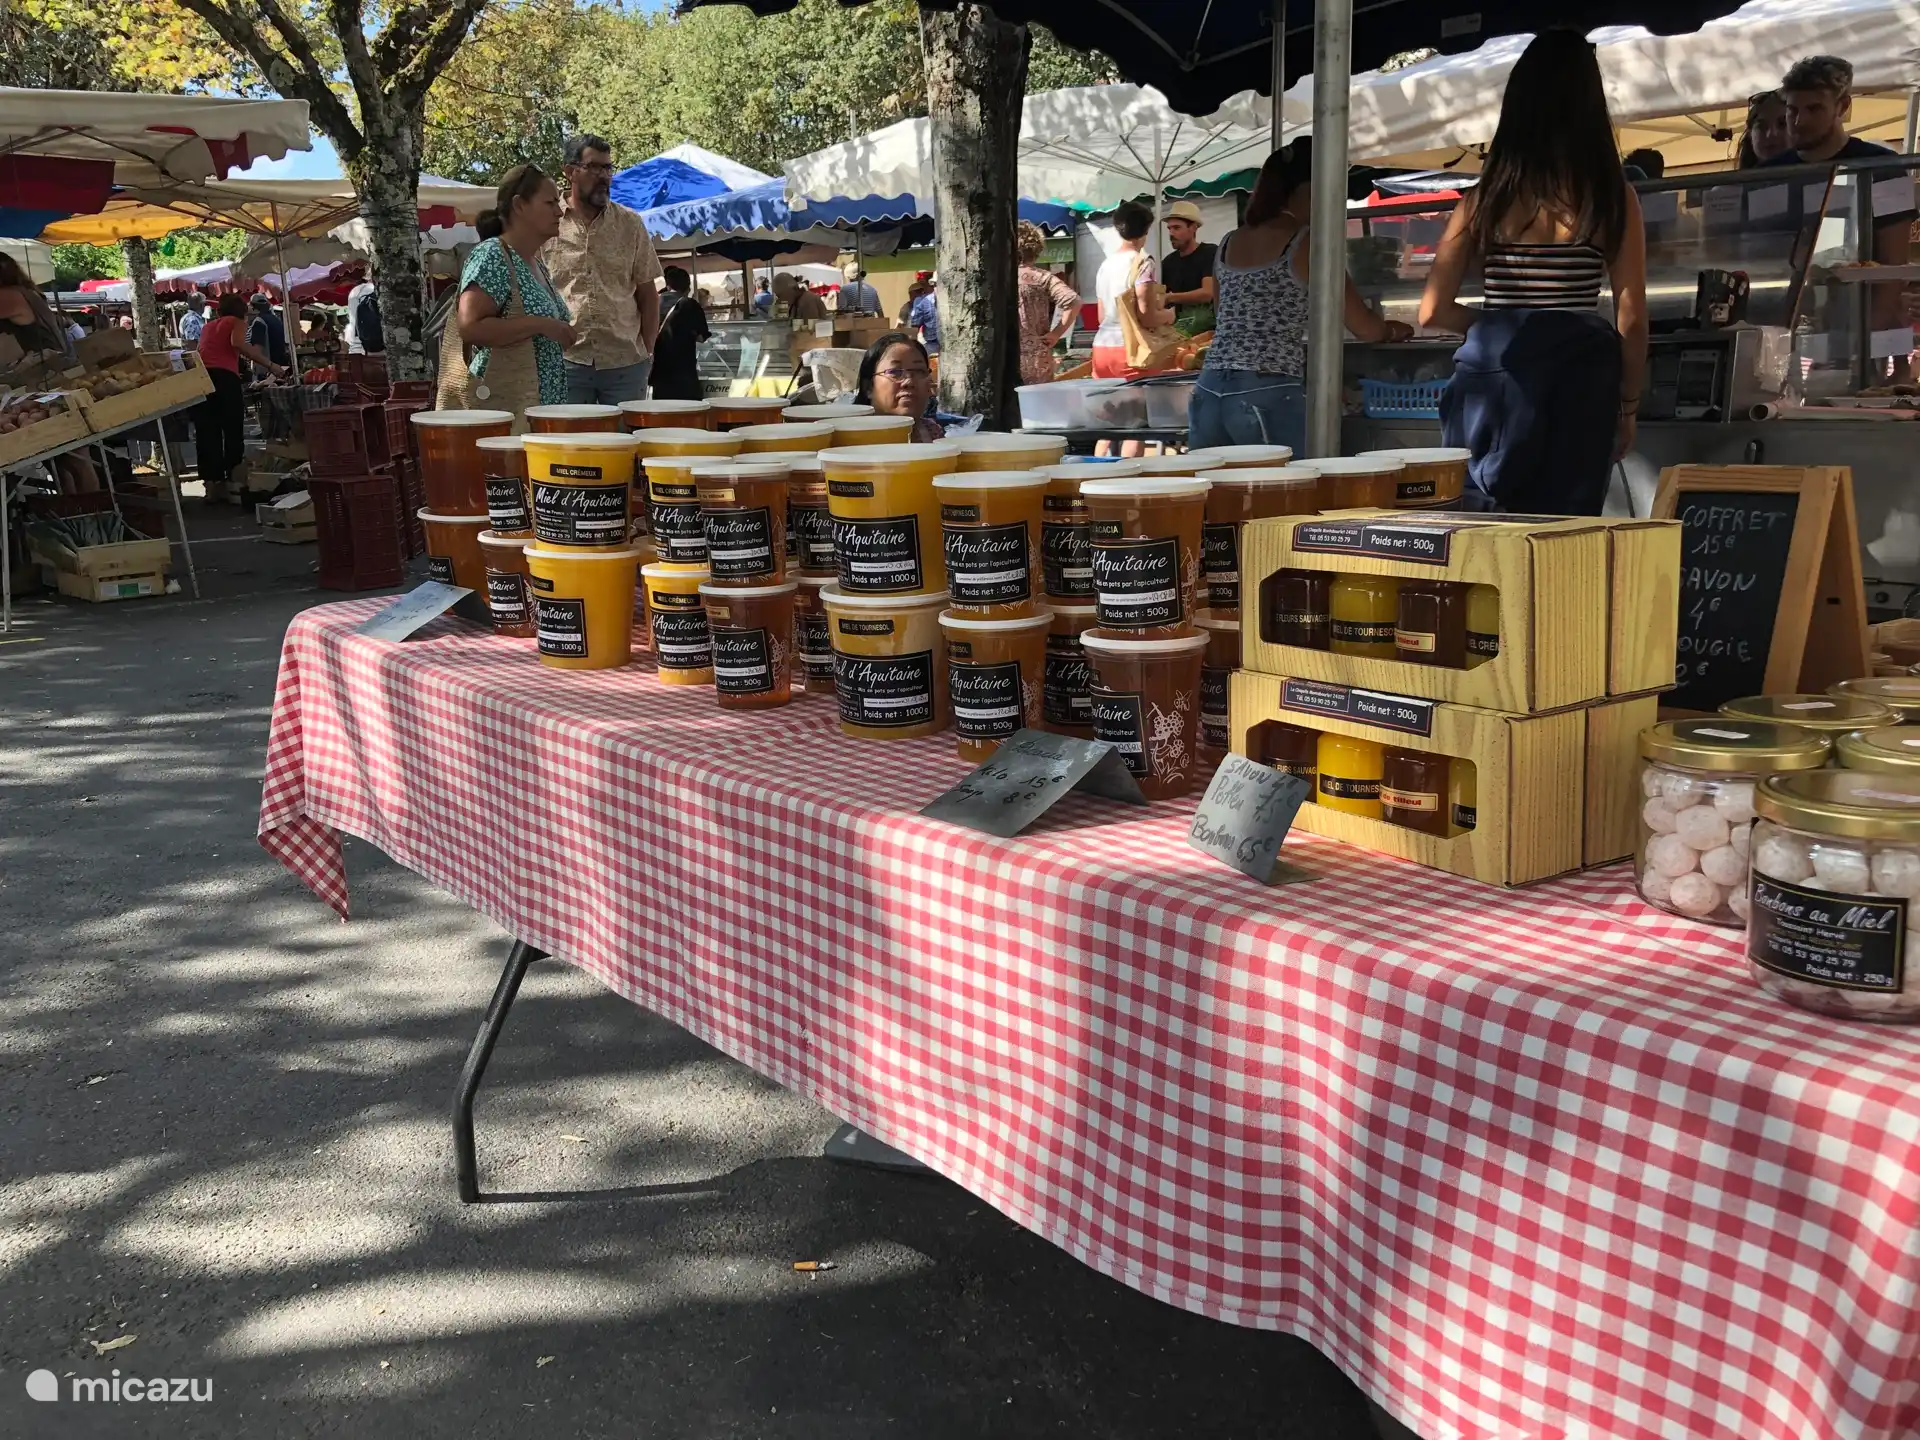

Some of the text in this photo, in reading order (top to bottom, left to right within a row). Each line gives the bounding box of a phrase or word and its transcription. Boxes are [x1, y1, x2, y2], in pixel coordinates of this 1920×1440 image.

[486, 484, 516, 497] uitaine
[1404, 485, 1432, 494] CACIA
[535, 486, 622, 513] Miel d'Aquitaine
[660, 507, 702, 530] d'Aquit
[1681, 505, 1787, 531] COFFRET
[576, 531, 592, 539] Poids
[838, 524, 907, 552] d'Aquitaine
[945, 534, 1020, 562] d'Aquitaine
[1371, 534, 1434, 553] Poids net 500g
[748, 560, 764, 569] 500g
[852, 574, 910, 584] Poids net 1000
[1681, 567, 1756, 591] AVON
[487, 580, 516, 592] uitaine
[962, 588, 980, 596] Poids
[1001, 585, 1020, 594] 500g
[1216, 588, 1232, 597] 500g
[534, 601, 574, 622] Aquitaine
[1105, 607, 1169, 618] Poids net 500g
[1300, 614, 1328, 623] SAUVAGE
[1344, 626, 1352, 635] DE
[1354, 627, 1394, 636] TOURNESO
[848, 662, 921, 688] d'Aquitaine
[744, 678, 761, 686] 500g
[864, 706, 924, 718] Poids net 1000
[1358, 700, 1418, 723] Poids net 500g
[959, 722, 973, 730] Poids
[993, 721, 1012, 730] 500g
[1294, 766, 1317, 775] SAUVAG
[1335, 781, 1344, 792] DE
[1346, 782, 1380, 794] TOURNES
[1393, 796, 1421, 806] tilleul
[1754, 884, 1896, 929] Bonbons au Miel
[1826, 955, 1839, 965] 25
[1806, 964, 1832, 977] Poids
[1835, 971, 1853, 980] net
